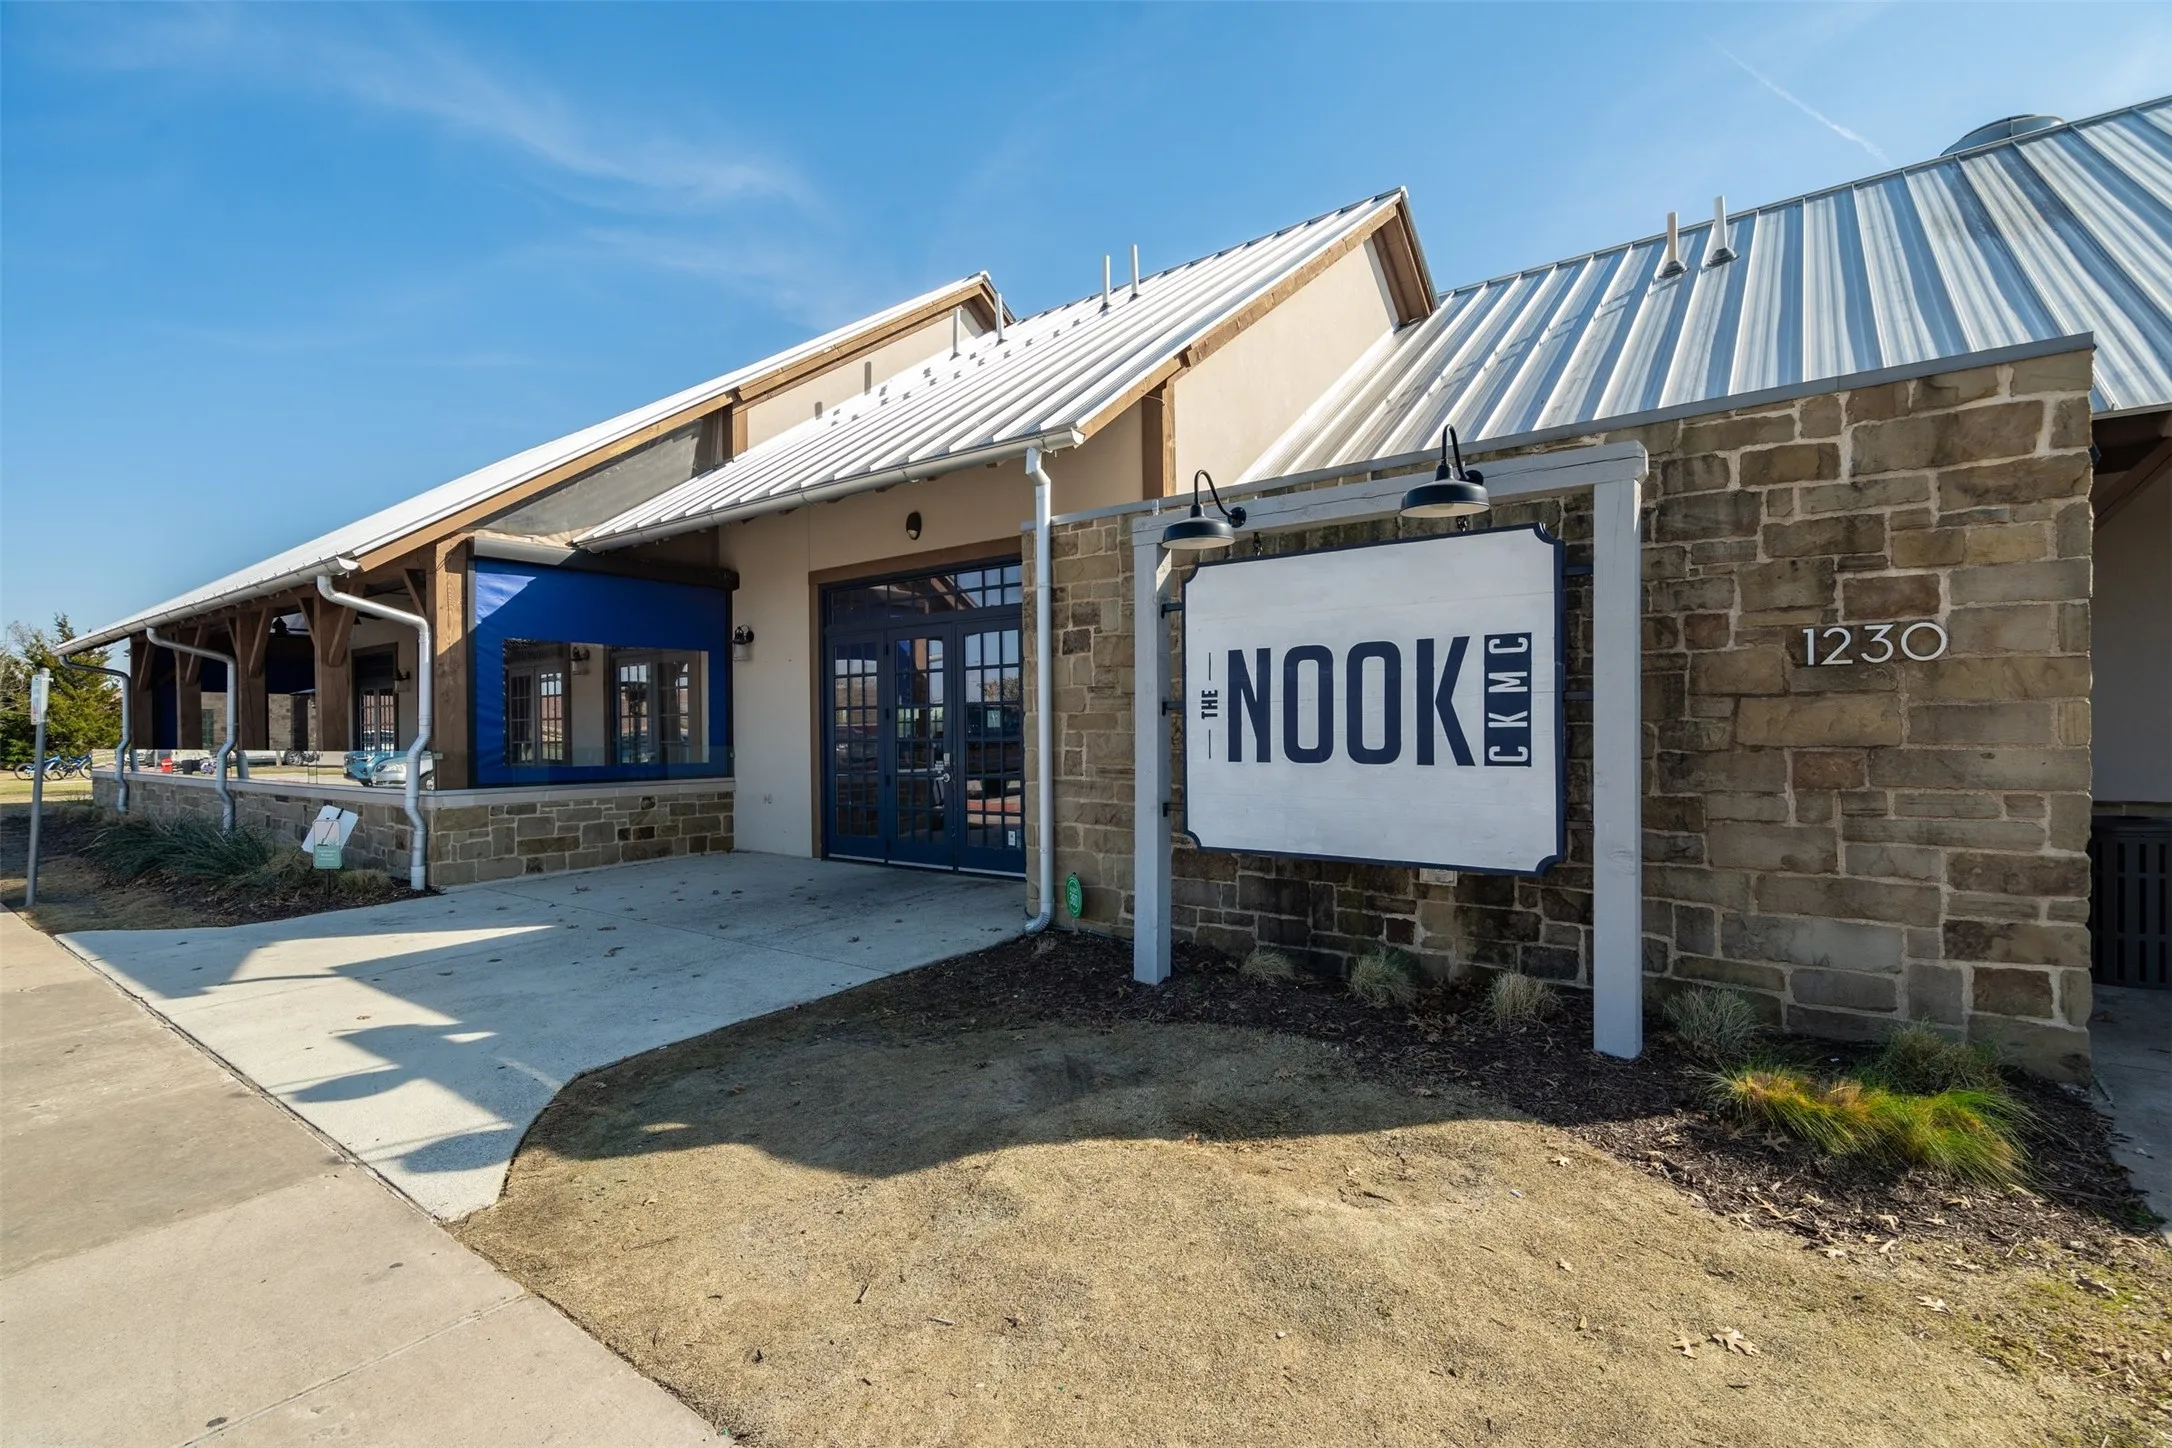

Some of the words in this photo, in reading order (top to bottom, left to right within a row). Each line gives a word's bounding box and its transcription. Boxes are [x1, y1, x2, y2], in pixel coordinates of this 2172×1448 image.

[1802, 622, 1948, 666] 1230
[1201, 689, 1218, 720] THE
[1227, 635, 1476, 766] NOOK
[1487, 636, 1530, 764] CKMC
